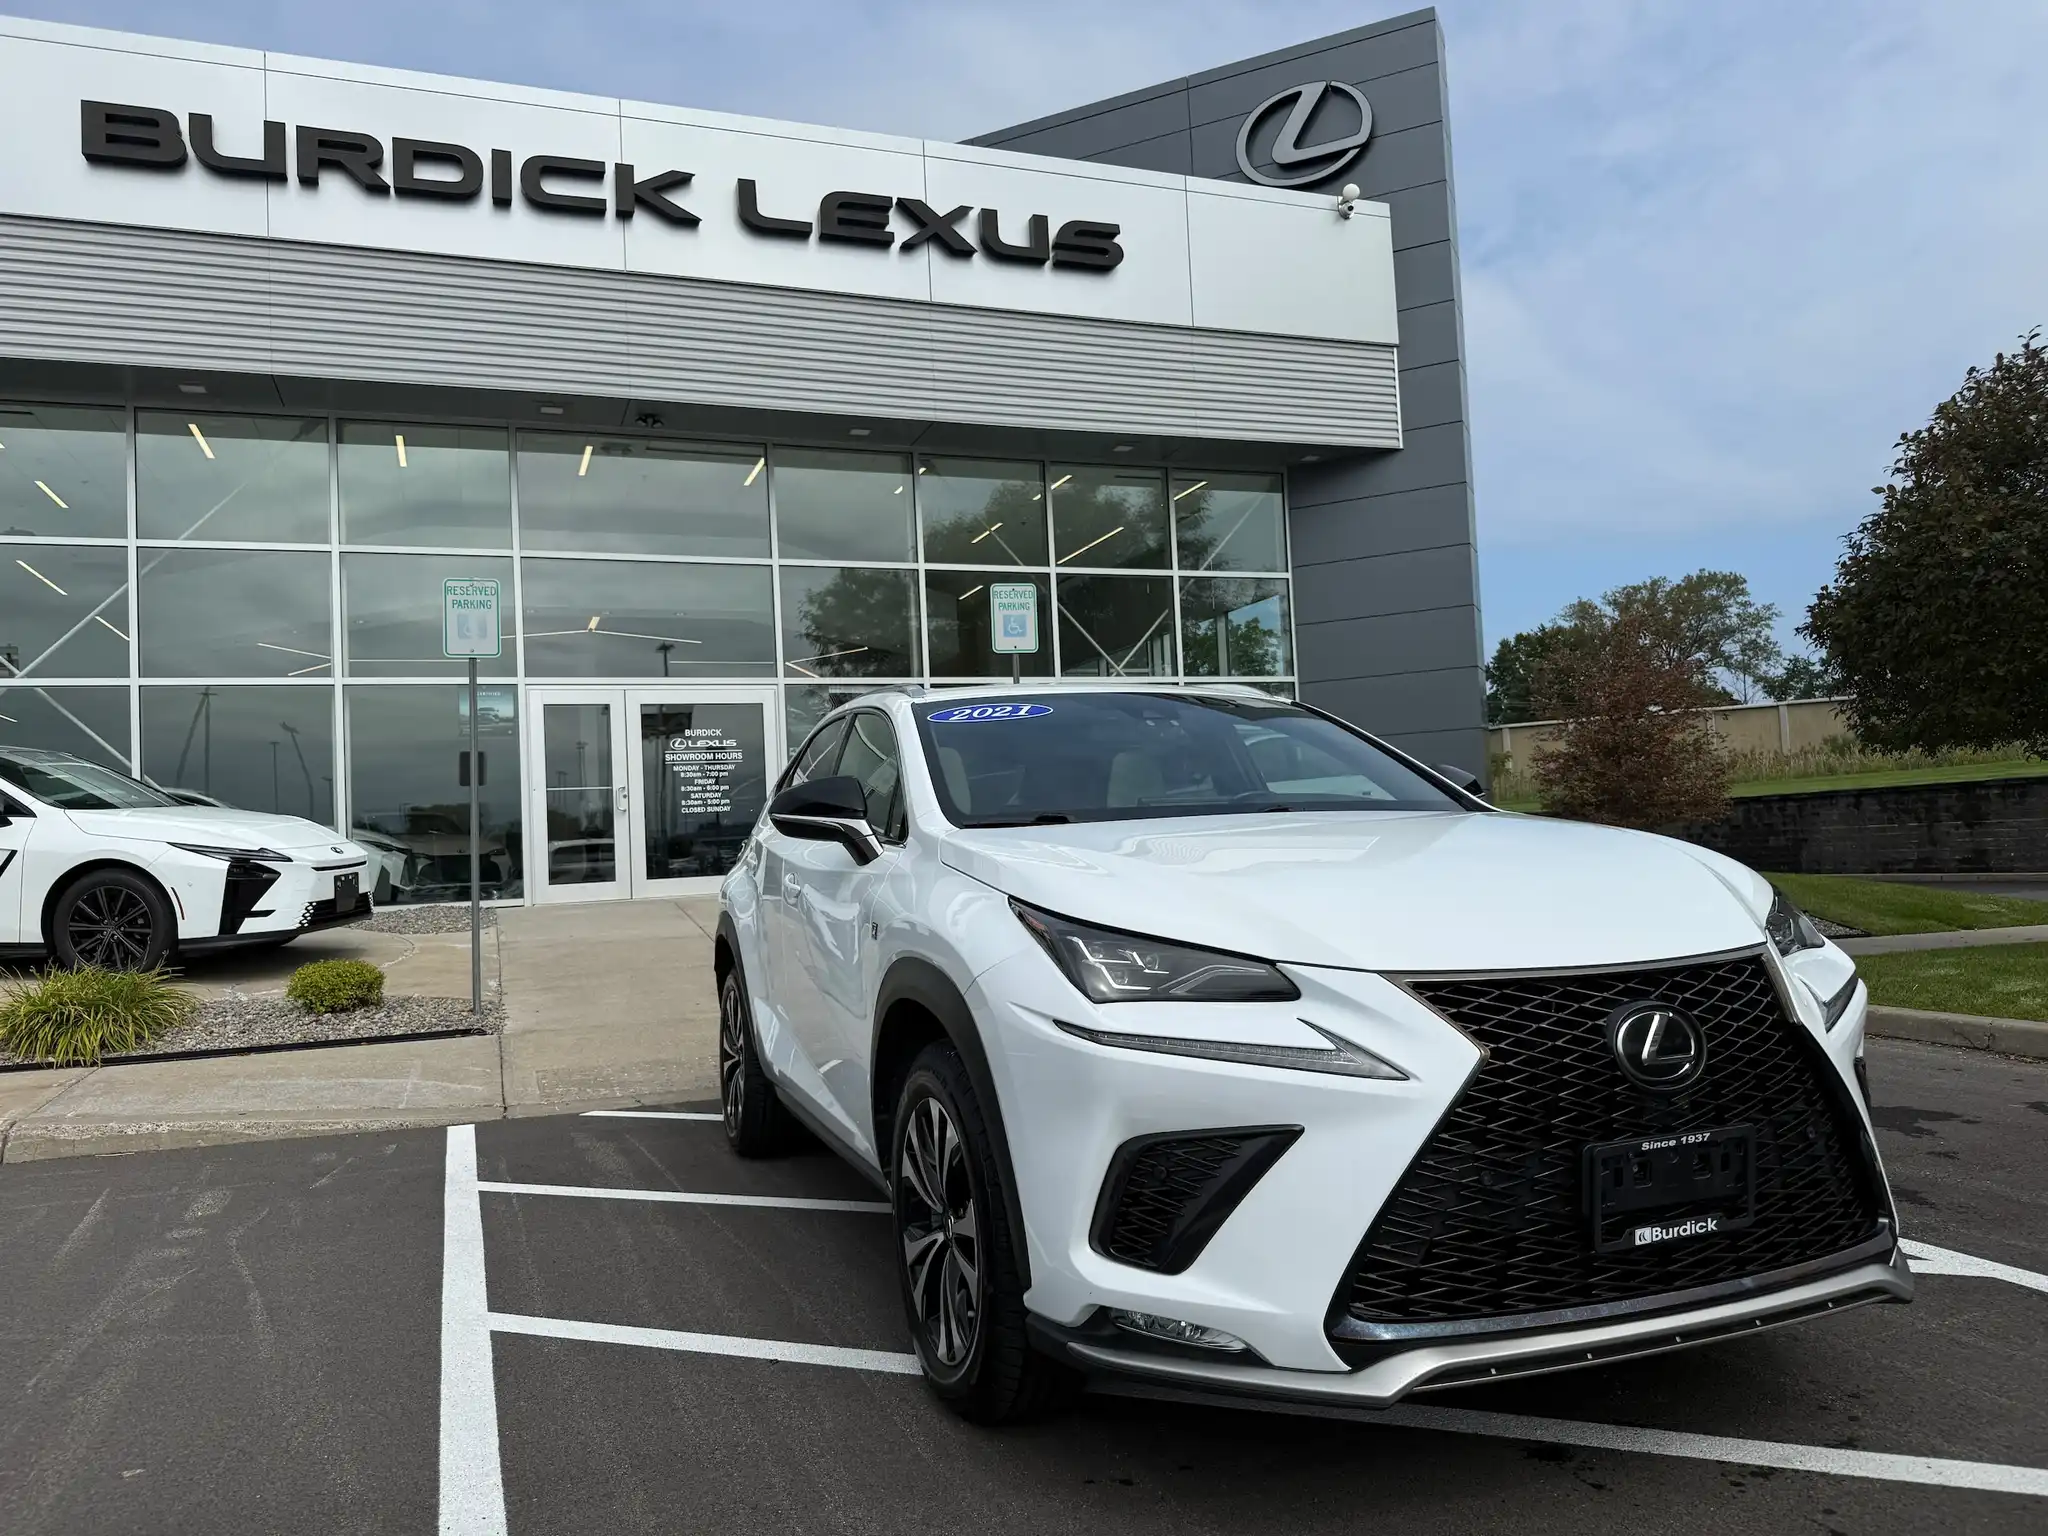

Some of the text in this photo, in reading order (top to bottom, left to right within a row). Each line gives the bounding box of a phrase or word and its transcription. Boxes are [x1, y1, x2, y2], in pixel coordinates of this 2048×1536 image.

[81, 99, 1125, 272] BURDICK LEXUS
[446, 586, 497, 597] RESERVED
[993, 590, 1033, 600] RESERVED
[452, 599, 492, 610] PARKING
[998, 602, 1031, 611] PARKING
[949, 705, 1032, 721] 2021
[684, 728, 722, 737] BURDICK
[688, 739, 737, 747] LEXUS
[664, 752, 743, 761] SHOWROOM HOURS
[1641, 1132, 1711, 1151] Since 1937
[1652, 1217, 1718, 1242] Burdick
